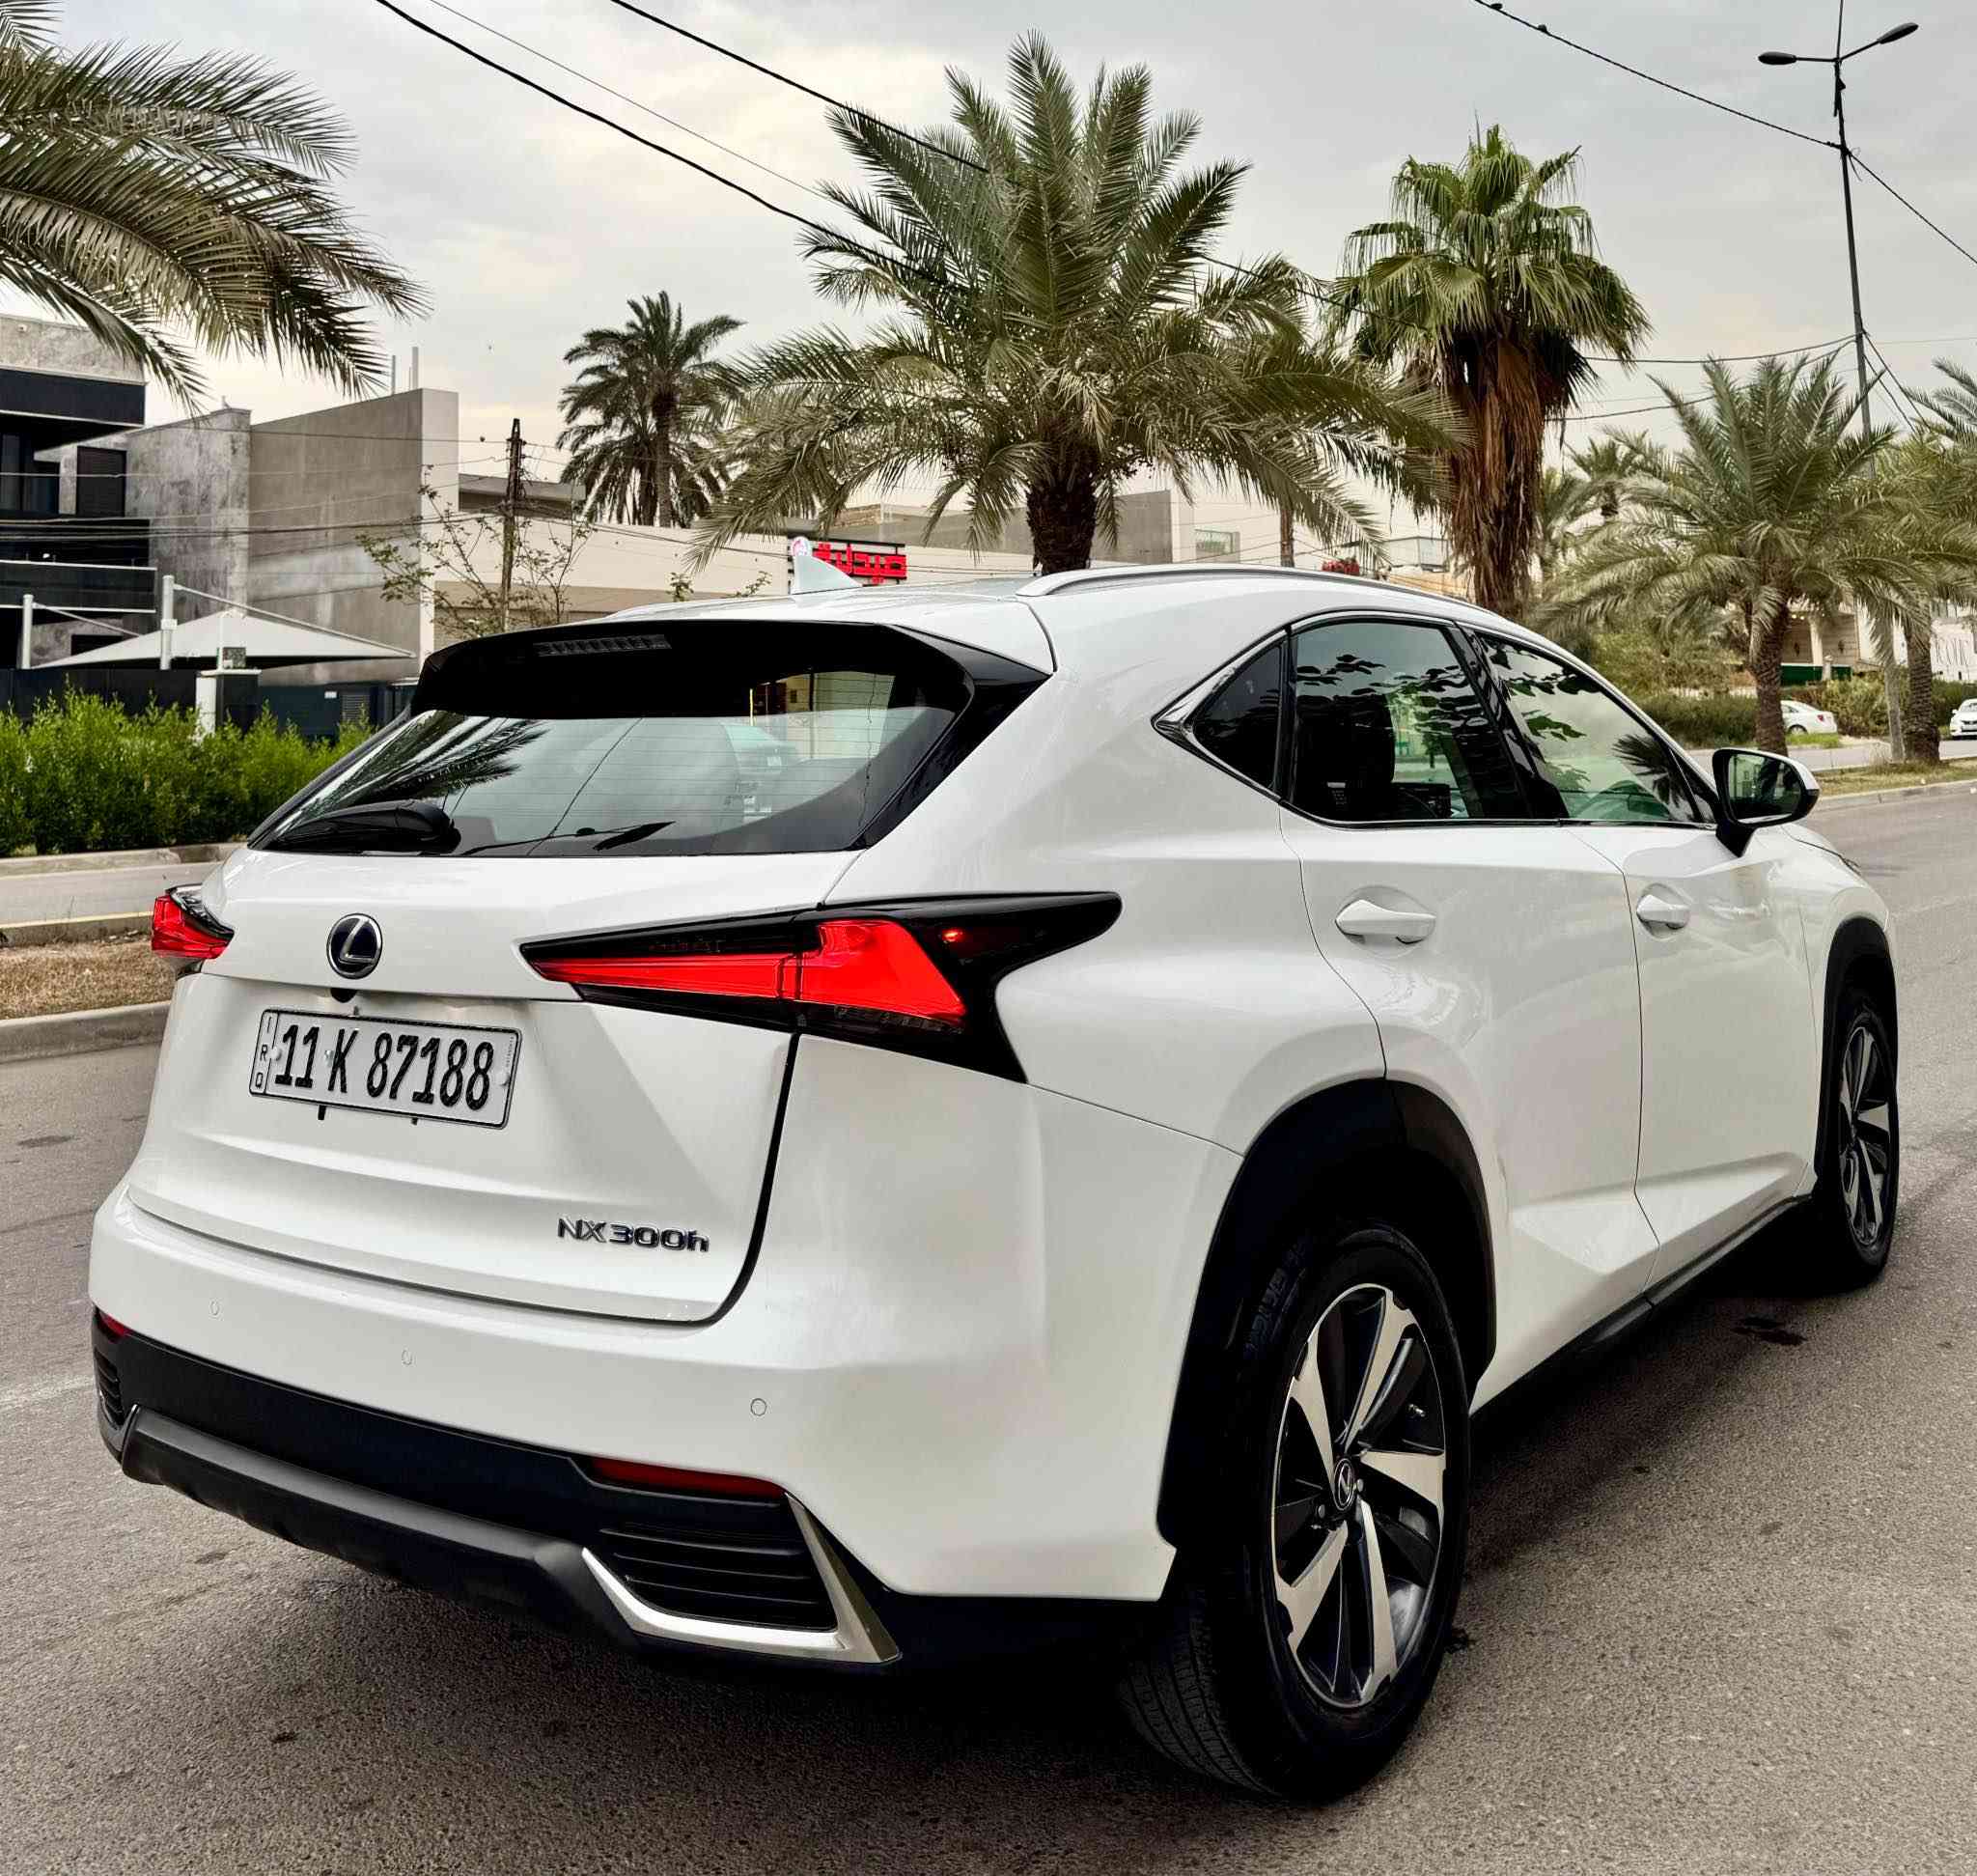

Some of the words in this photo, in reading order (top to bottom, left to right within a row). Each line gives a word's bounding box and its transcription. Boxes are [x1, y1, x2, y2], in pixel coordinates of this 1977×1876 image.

[275, 1024, 320, 1089] 11
[327, 1028, 358, 1093] K
[366, 1032, 494, 1110] 87188
